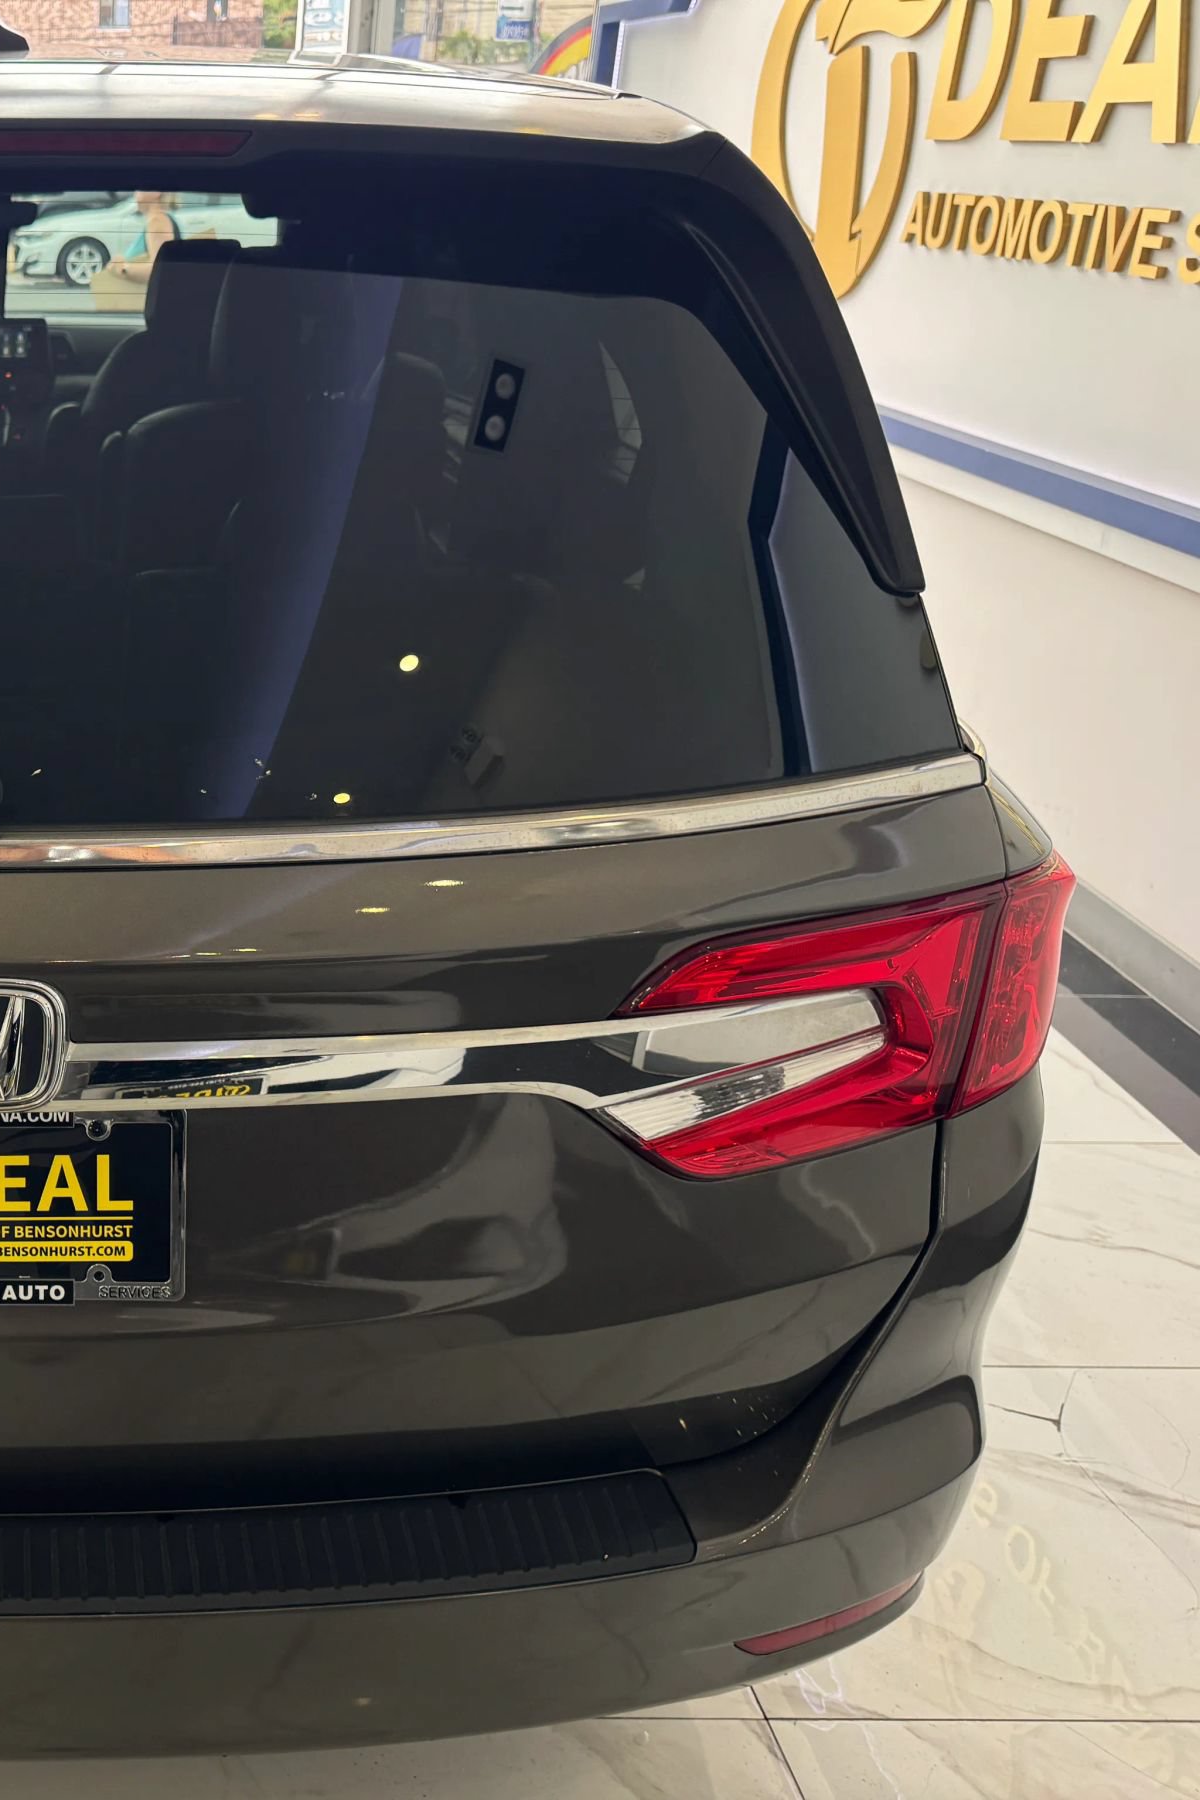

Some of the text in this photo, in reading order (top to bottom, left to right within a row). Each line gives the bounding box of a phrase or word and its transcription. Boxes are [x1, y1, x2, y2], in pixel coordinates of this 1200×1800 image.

[902, 191, 1181, 280] AUTOMOTIVE
[14, 1225, 133, 1238] BENSONHURST
[2, 1284, 66, 1301] AUTO
[99, 1286, 171, 1300] SERVICES
